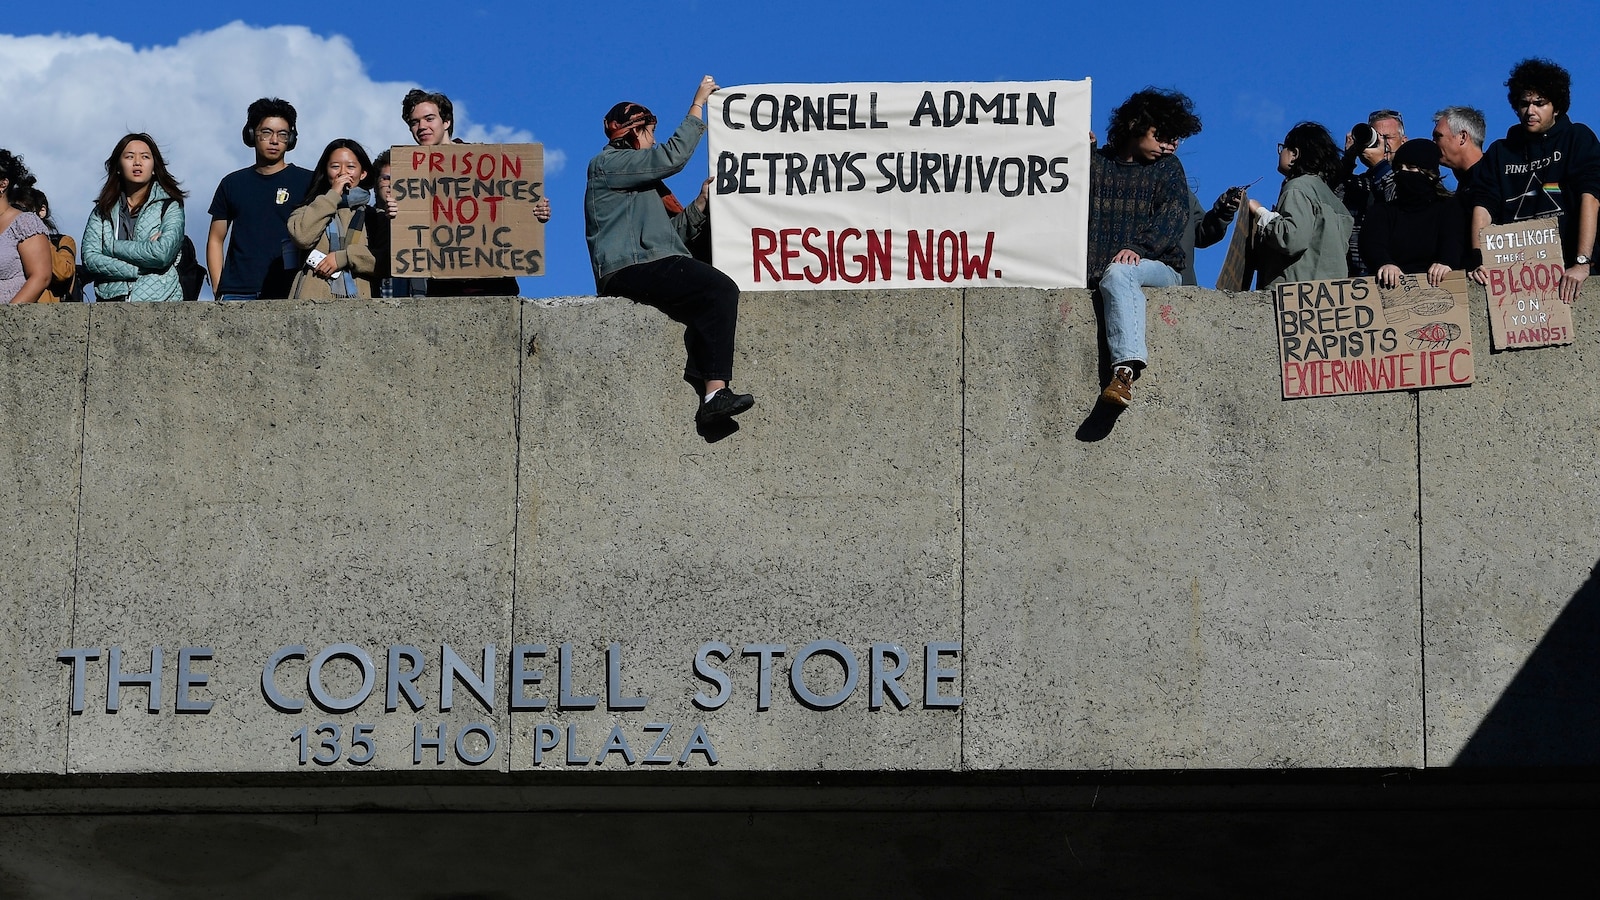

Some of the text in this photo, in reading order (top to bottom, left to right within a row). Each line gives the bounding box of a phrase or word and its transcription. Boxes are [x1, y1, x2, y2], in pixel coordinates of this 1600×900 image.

[722, 90, 1057, 132] CORNELL ADMIN
[412, 151, 522, 181] PRISON
[716, 150, 1069, 197] BETRAYS SURVIVORS
[1504, 164, 1529, 174] PINK
[392, 177, 543, 202] SENTENCES
[432, 195, 505, 224] NOT
[408, 224, 513, 248] TOPIC
[1485, 228, 1558, 250] KOTLIKOFF,
[395, 247, 542, 275] SENTENCES
[751, 226, 1002, 284] RESIGN NOW.
[1495, 250, 1547, 264] THERE IS
[1489, 263, 1566, 296] BLOOD
[1278, 279, 1370, 311] FRATS
[1517, 298, 1540, 311] ON
[1280, 305, 1375, 337] BREED
[1511, 312, 1547, 326] YOUR
[1283, 328, 1398, 362] RAPISTS
[1506, 327, 1567, 344] HANDS!
[1283, 348, 1471, 396] EXTERMINATE IFC
[57, 639, 963, 714] THE CORNELL STORE
[291, 721, 720, 765] 135 HO PLAZA
